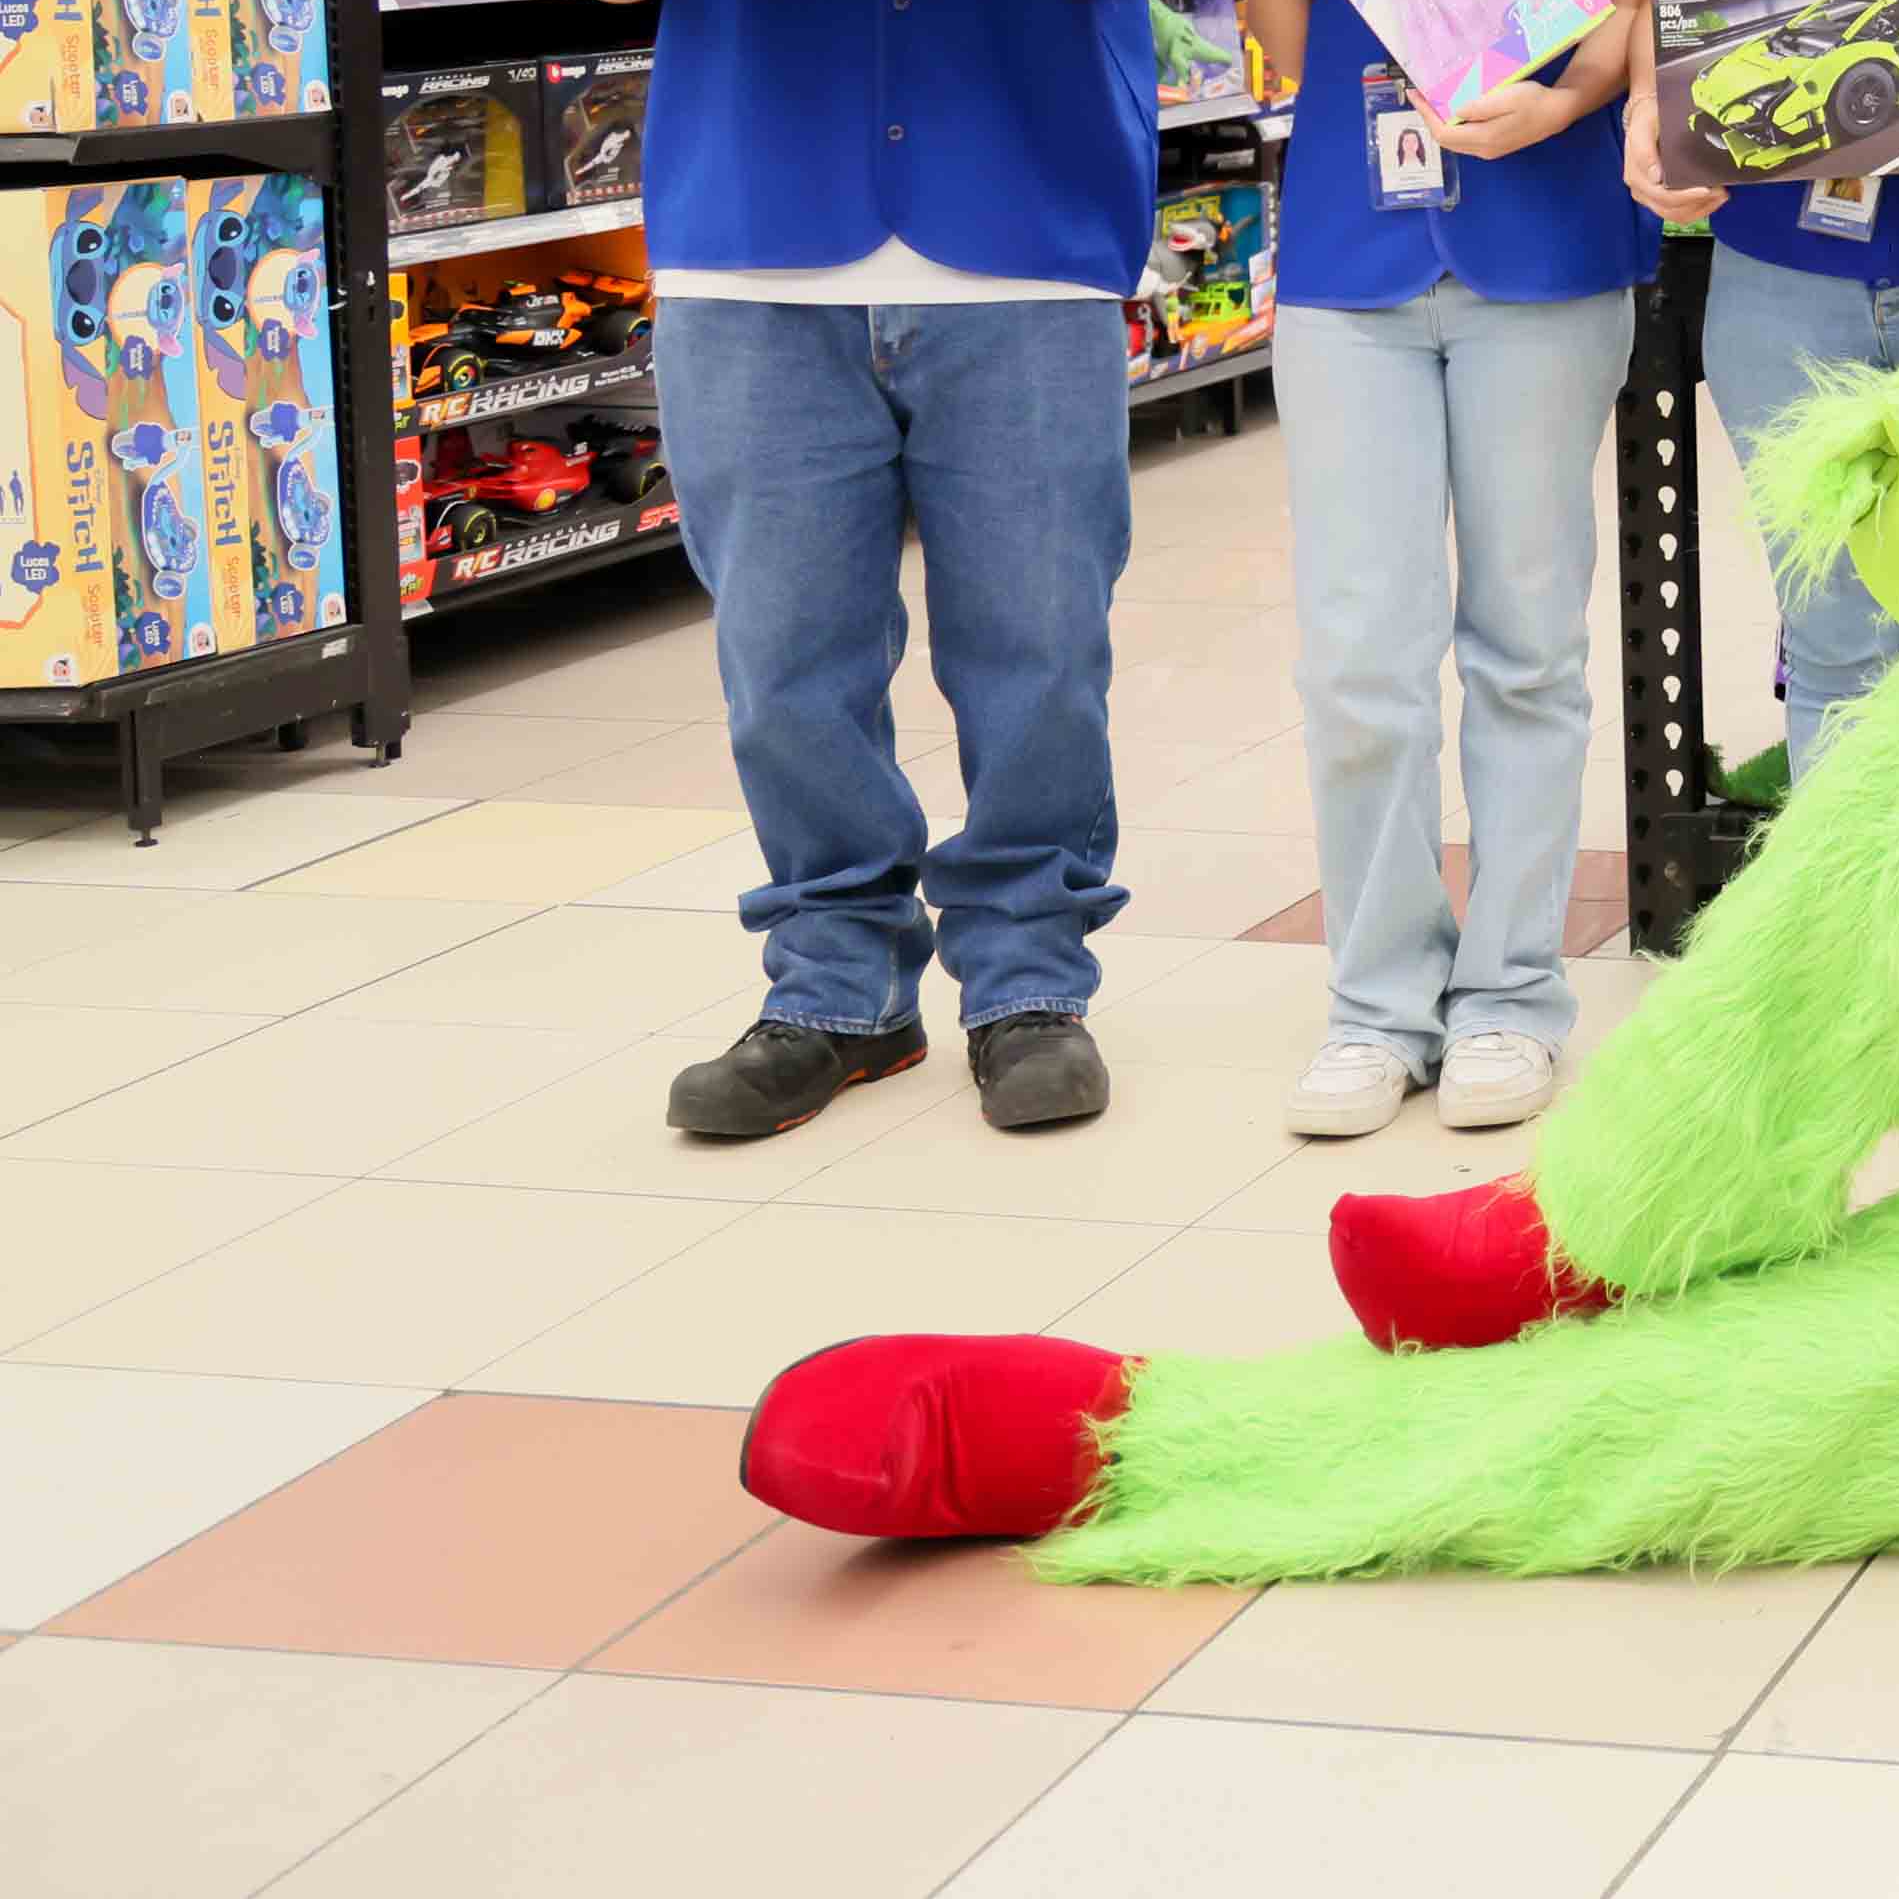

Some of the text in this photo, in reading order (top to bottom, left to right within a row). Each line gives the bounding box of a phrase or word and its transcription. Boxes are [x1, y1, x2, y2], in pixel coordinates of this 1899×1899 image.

[1659, 4, 1682, 18] 806
[2, 14, 26, 27] LED
[470, 374, 591, 416] RACING
[500, 520, 621, 568] RACING
[19, 555, 50, 567] Luces
[25, 568, 48, 581] LED
